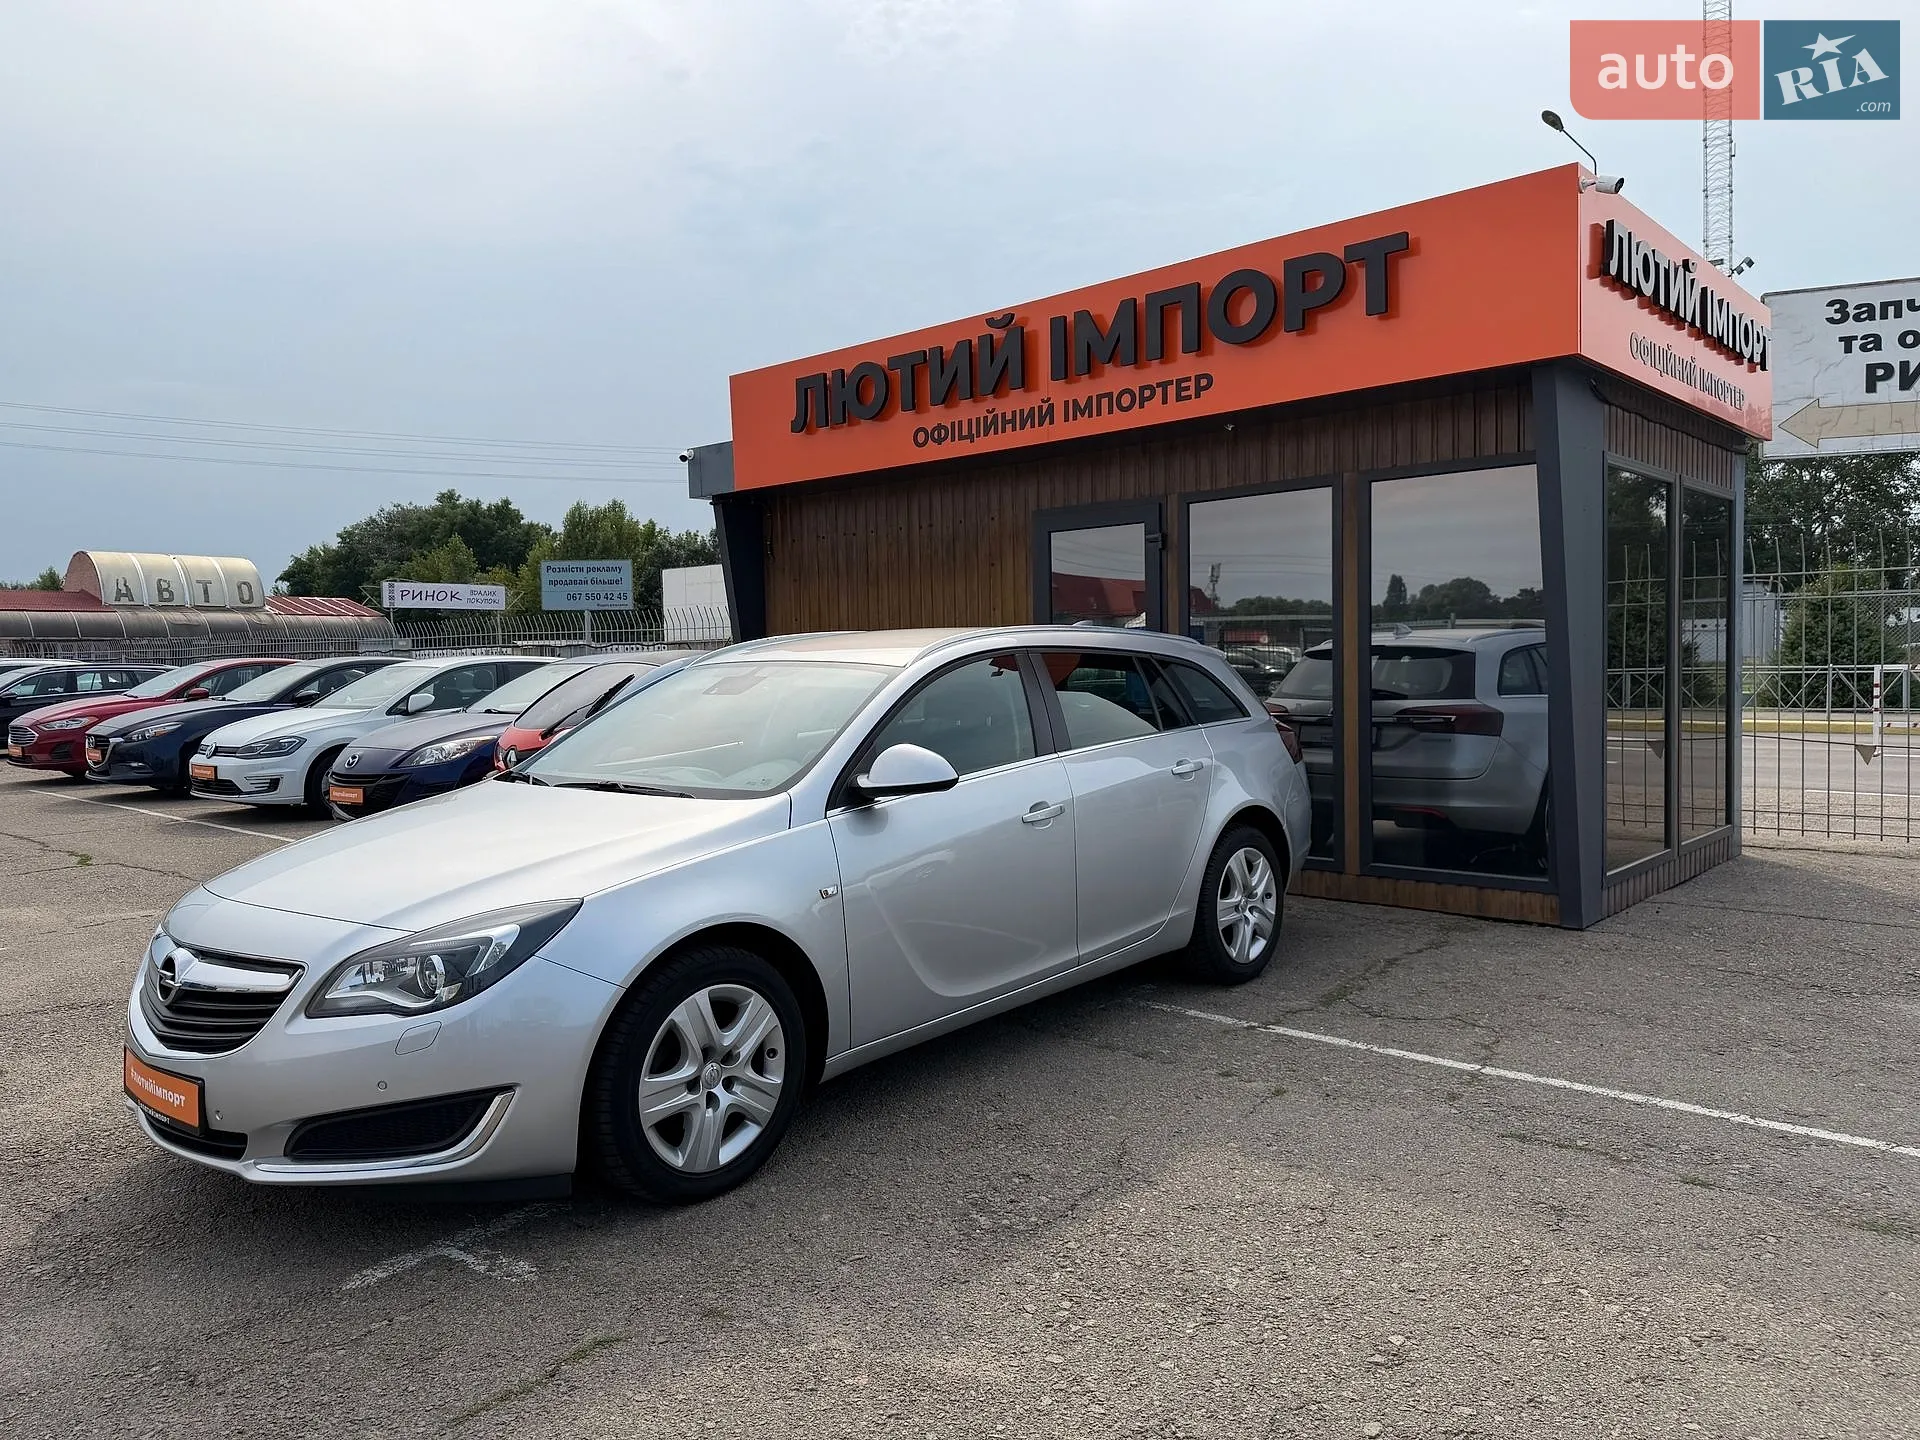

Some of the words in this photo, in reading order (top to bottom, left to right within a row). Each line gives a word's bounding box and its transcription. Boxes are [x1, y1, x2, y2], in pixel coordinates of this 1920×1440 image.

[1605, 219, 1702, 329] ЛЮТИЙ
[1700, 286, 1771, 372] ІМПОРТ
[790, 313, 1026, 433] ЛЮТИЙ
[1050, 231, 1410, 381] ІМПОРТ
[1838, 333, 1883, 354] та
[1629, 331, 1698, 390] ОФІЦІЙНИЙ
[912, 397, 1055, 448] ОФІЦІЙНИЙ
[1063, 373, 1214, 422] ІМПОРТЕР
[546, 565, 584, 574] Розмісти
[586, 565, 623, 574] рекламу
[548, 577, 589, 587] продавай
[590, 577, 623, 586] більше!
[400, 589, 462, 602] РИНОК
[566, 592, 583, 601] 067
[584, 592, 601, 601] 550
[603, 592, 615, 601] 42
[616, 592, 628, 601] 45
